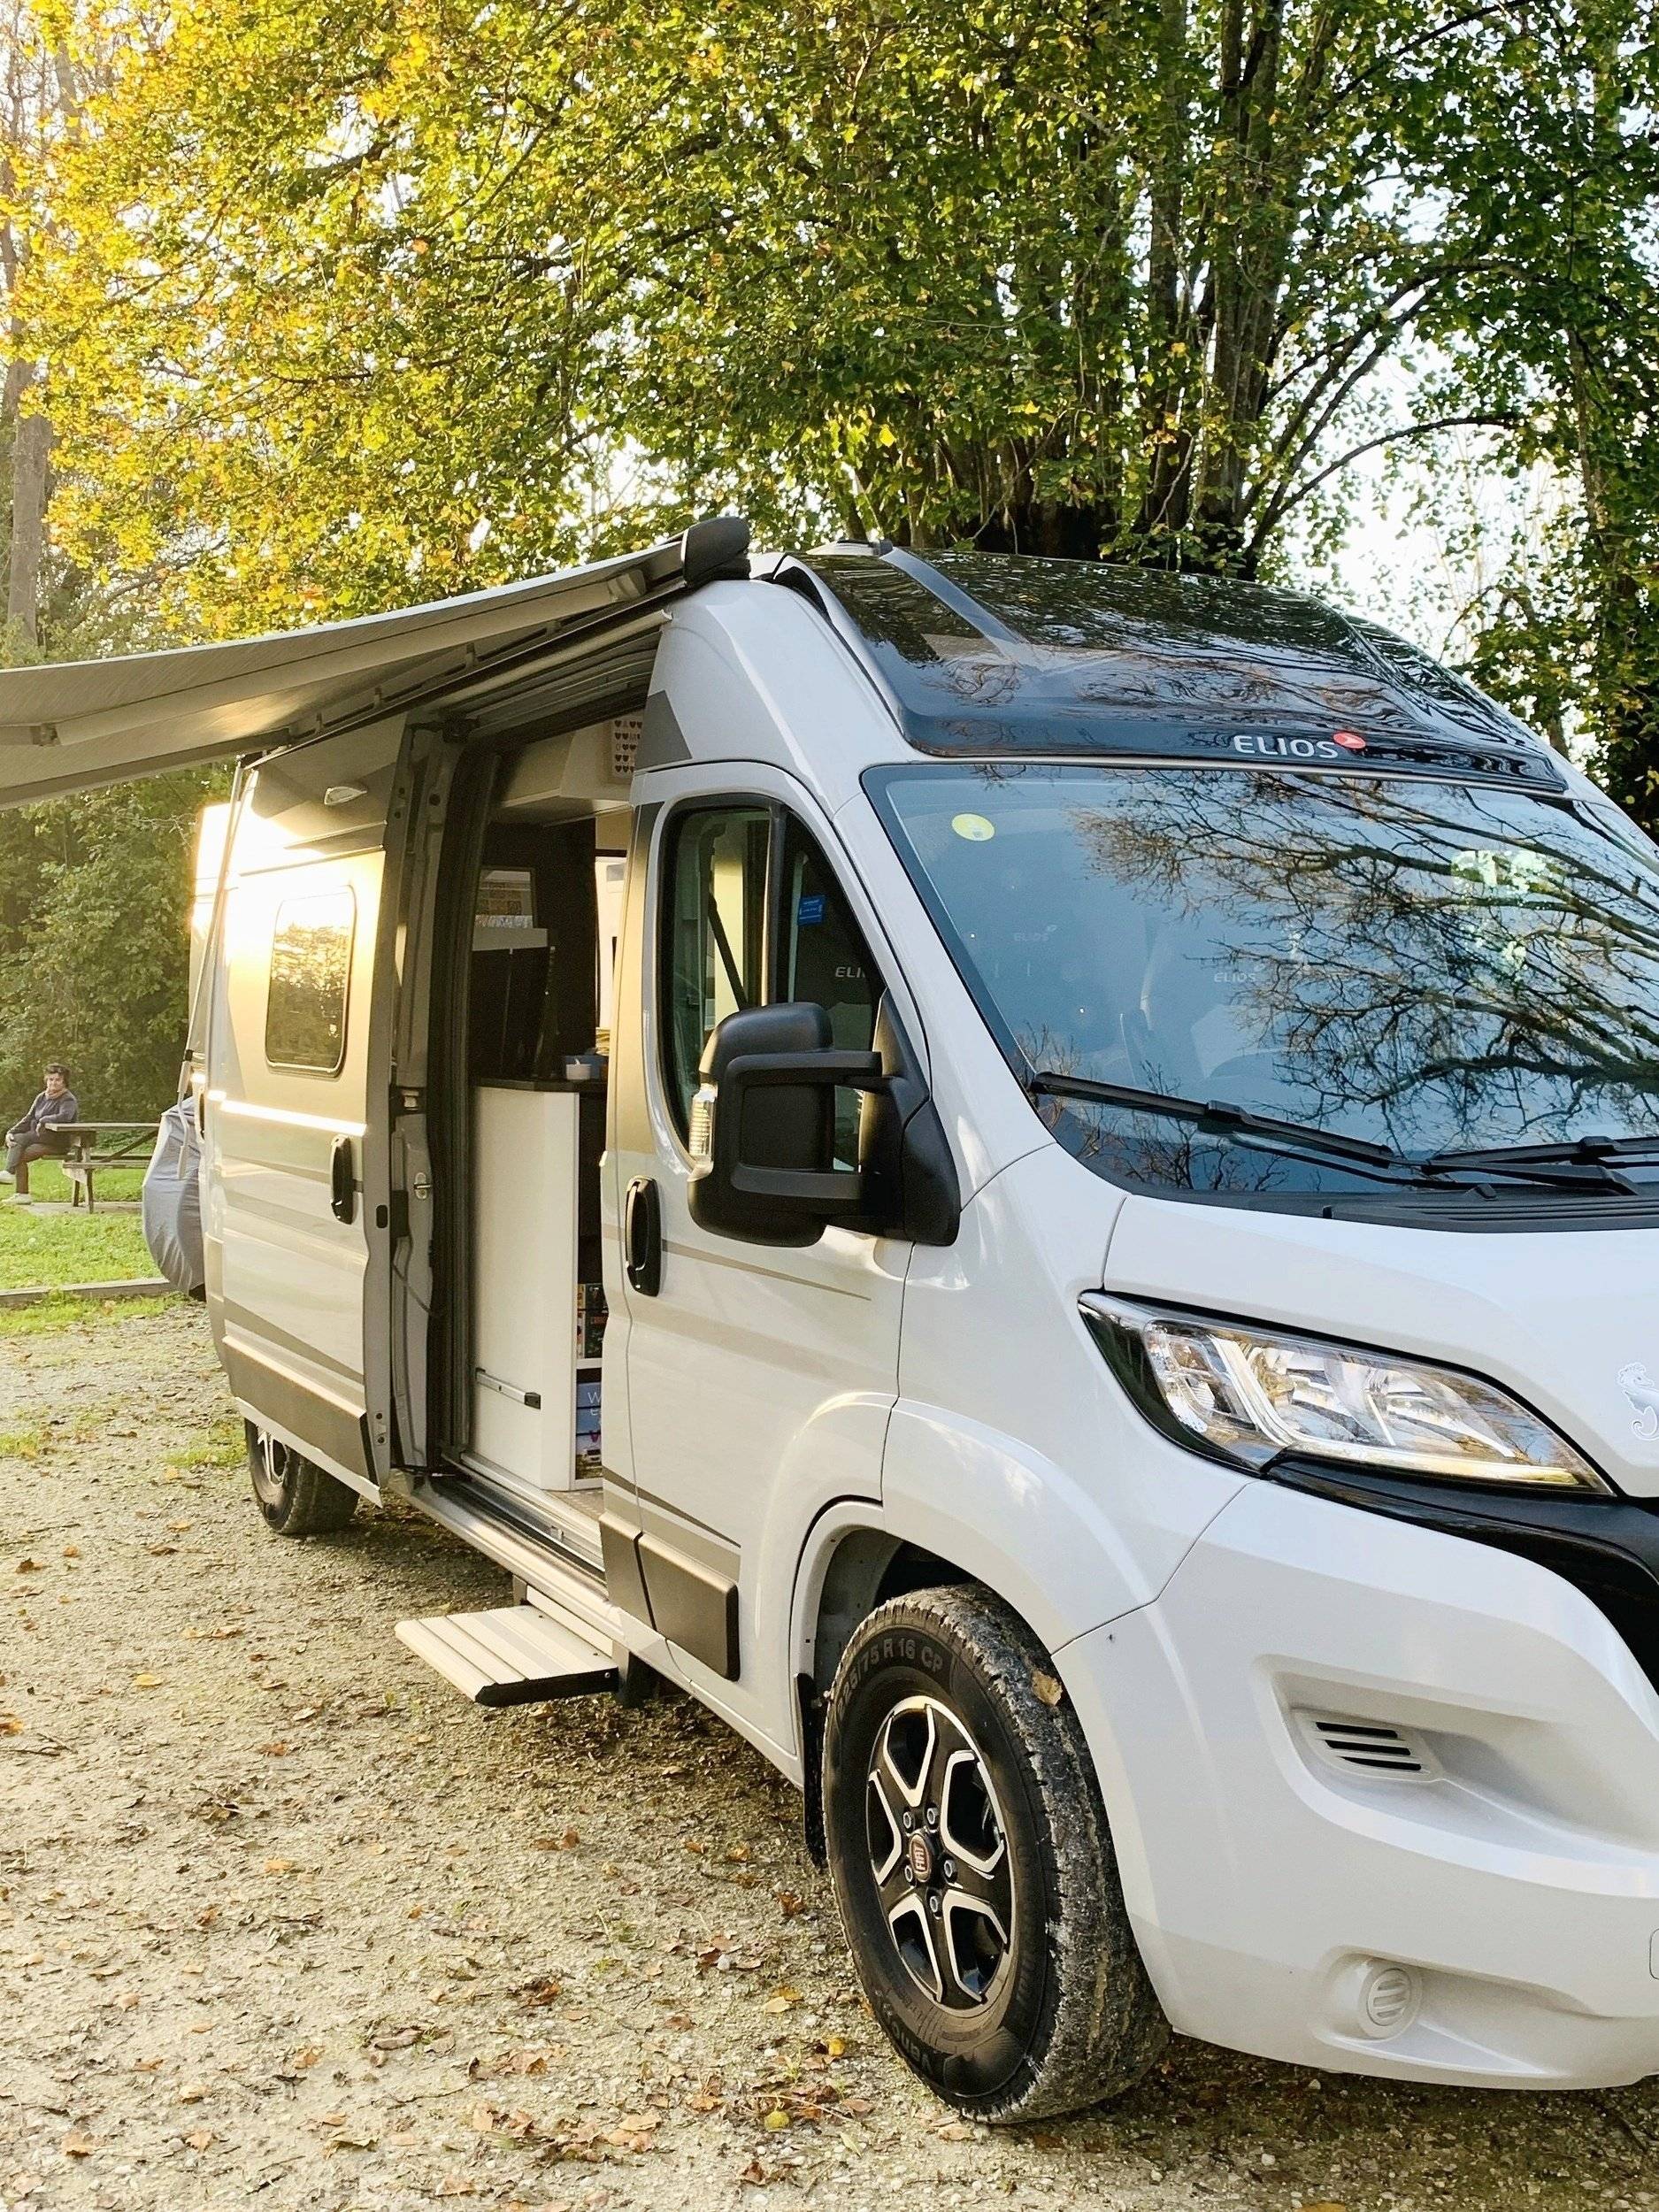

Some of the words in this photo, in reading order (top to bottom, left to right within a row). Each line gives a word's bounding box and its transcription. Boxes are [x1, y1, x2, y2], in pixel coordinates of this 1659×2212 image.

[1233, 734, 1338, 758] ELIOS
[835, 966, 866, 979] ELI
[1214, 972, 1256, 983] ELIOS
[883, 1638, 894, 1658] R
[898, 1638, 916, 1659] 16
[921, 1646, 943, 1672] CP
